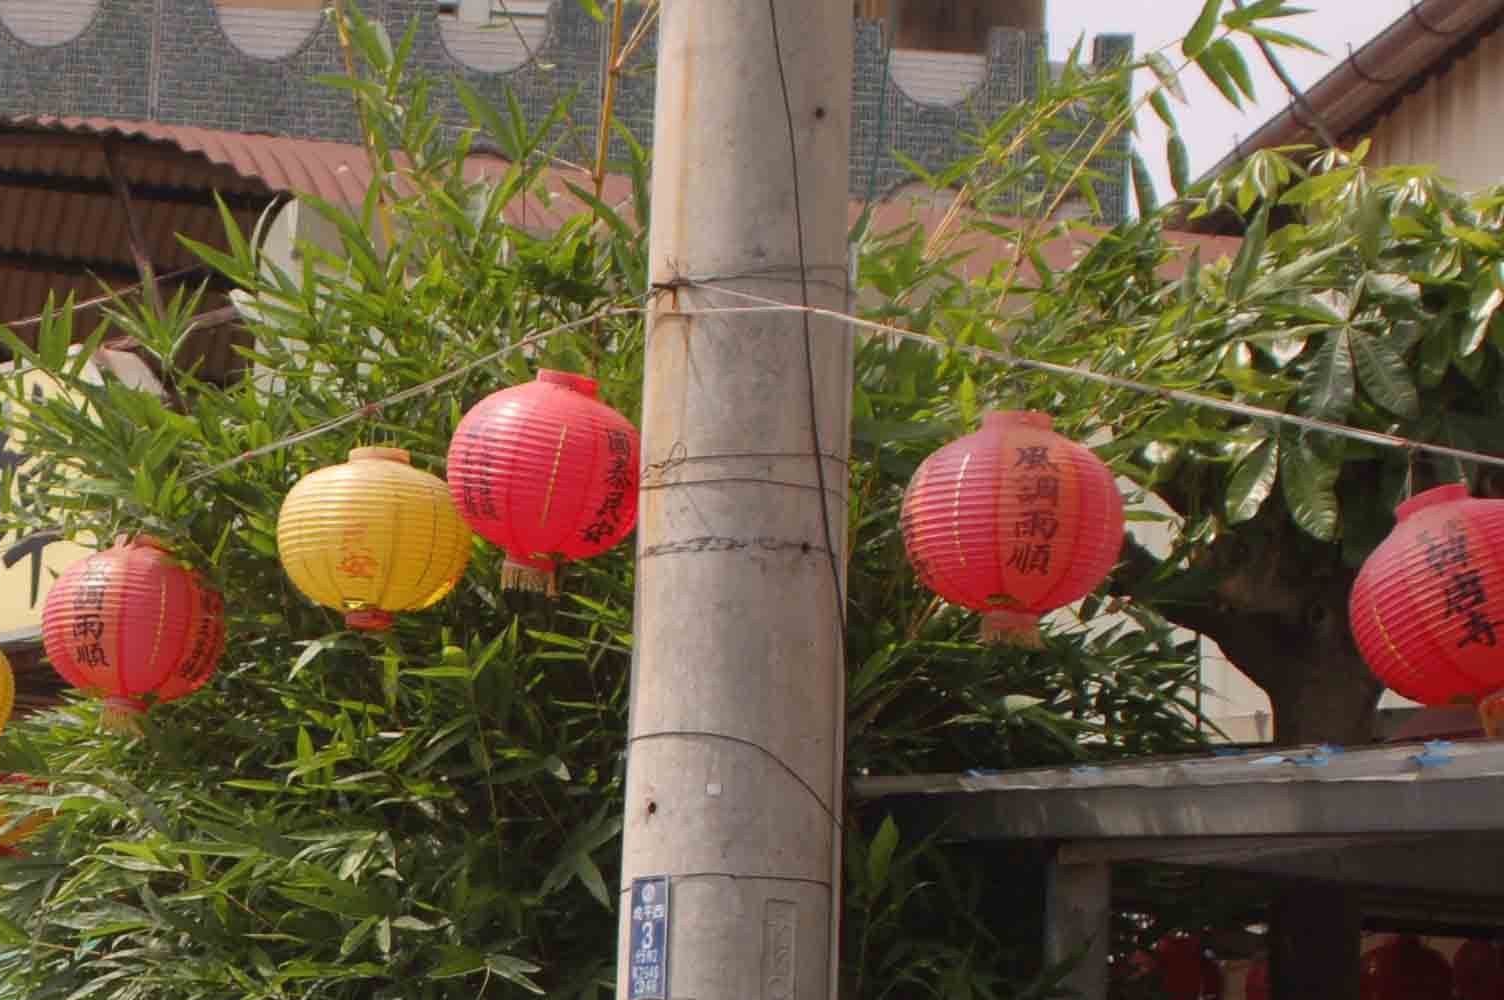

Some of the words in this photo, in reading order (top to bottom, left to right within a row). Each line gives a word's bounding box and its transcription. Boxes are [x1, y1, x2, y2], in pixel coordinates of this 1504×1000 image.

[582, 428, 634, 544] 國泰民安
[1007, 447, 1062, 576] 風調雨順
